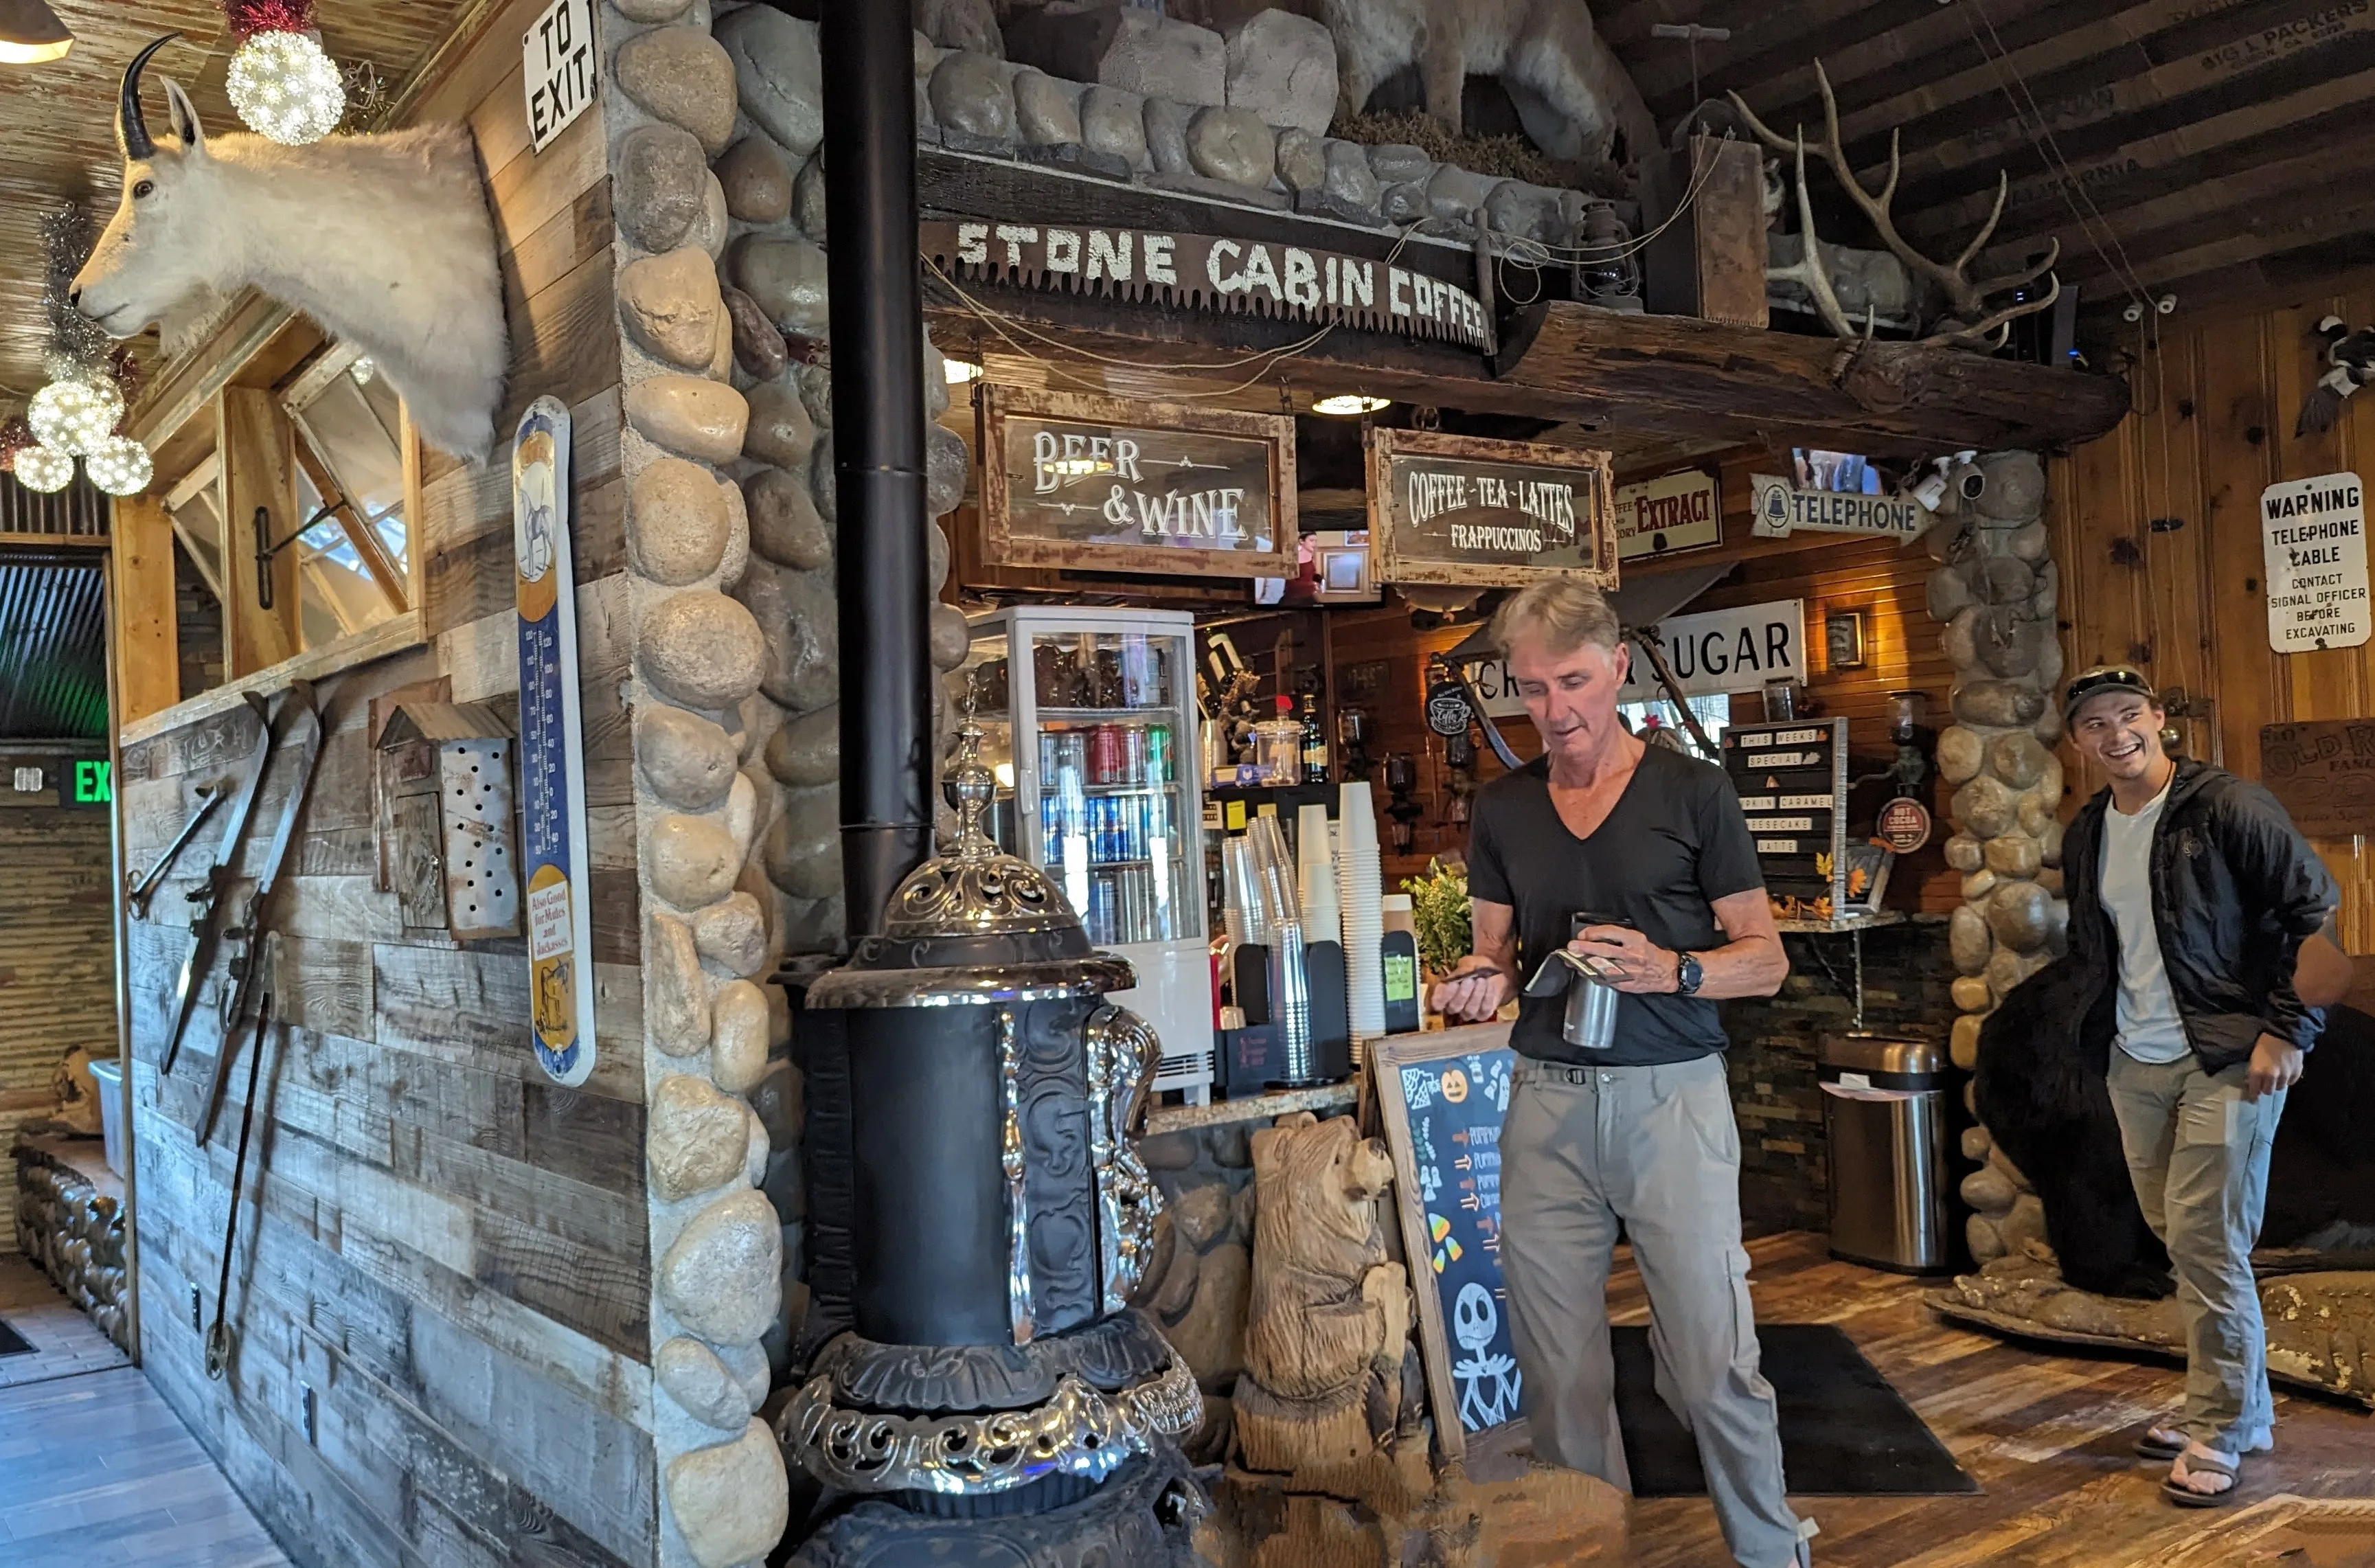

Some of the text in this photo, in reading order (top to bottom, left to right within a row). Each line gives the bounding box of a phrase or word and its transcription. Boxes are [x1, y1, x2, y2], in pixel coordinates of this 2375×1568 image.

[2263, 1, 2369, 45] PACKERS
[540, 0, 571, 71] TO
[532, 43, 587, 143] EXIT
[958, 223, 1485, 338] STONE CABIN COFFEE
[1033, 431, 1144, 495] BEER
[1104, 484, 1249, 541] & WINE
[1409, 471, 1468, 528] COFFEE
[1477, 477, 1510, 508] TEA
[1519, 481, 1574, 538] LATTES
[1614, 501, 1633, 514] FFEE
[1636, 490, 1710, 533] EXTRACT
[1791, 493, 1916, 531] TELEPHONE
[2266, 487, 2359, 519] WARNING
[1451, 524, 1542, 552] FRAPPUCCINOS
[1616, 527, 1636, 538] CORY
[2272, 520, 2359, 545] TELEPHONE
[2289, 547, 2340, 567] CABLE
[2292, 573, 2343, 589] CONTACT
[2271, 588, 2365, 608] SIGNAL OFFICER
[2297, 607, 2340, 622] BEFORE
[2286, 623, 2355, 639] EXCAVATING
[1742, 731, 1814, 744] THIS WEEKS
[1750, 755, 1798, 765] SPECIAL
[76, 761, 111, 802] EX
[1741, 797, 1832, 807] PKIN CARAMEL
[1751, 820, 1808, 828] EESECAKE
[1760, 842, 1793, 850] LATTE
[532, 889, 566, 910] Also Good
[535, 907, 565, 927] for Mules
[543, 923, 556, 938] and
